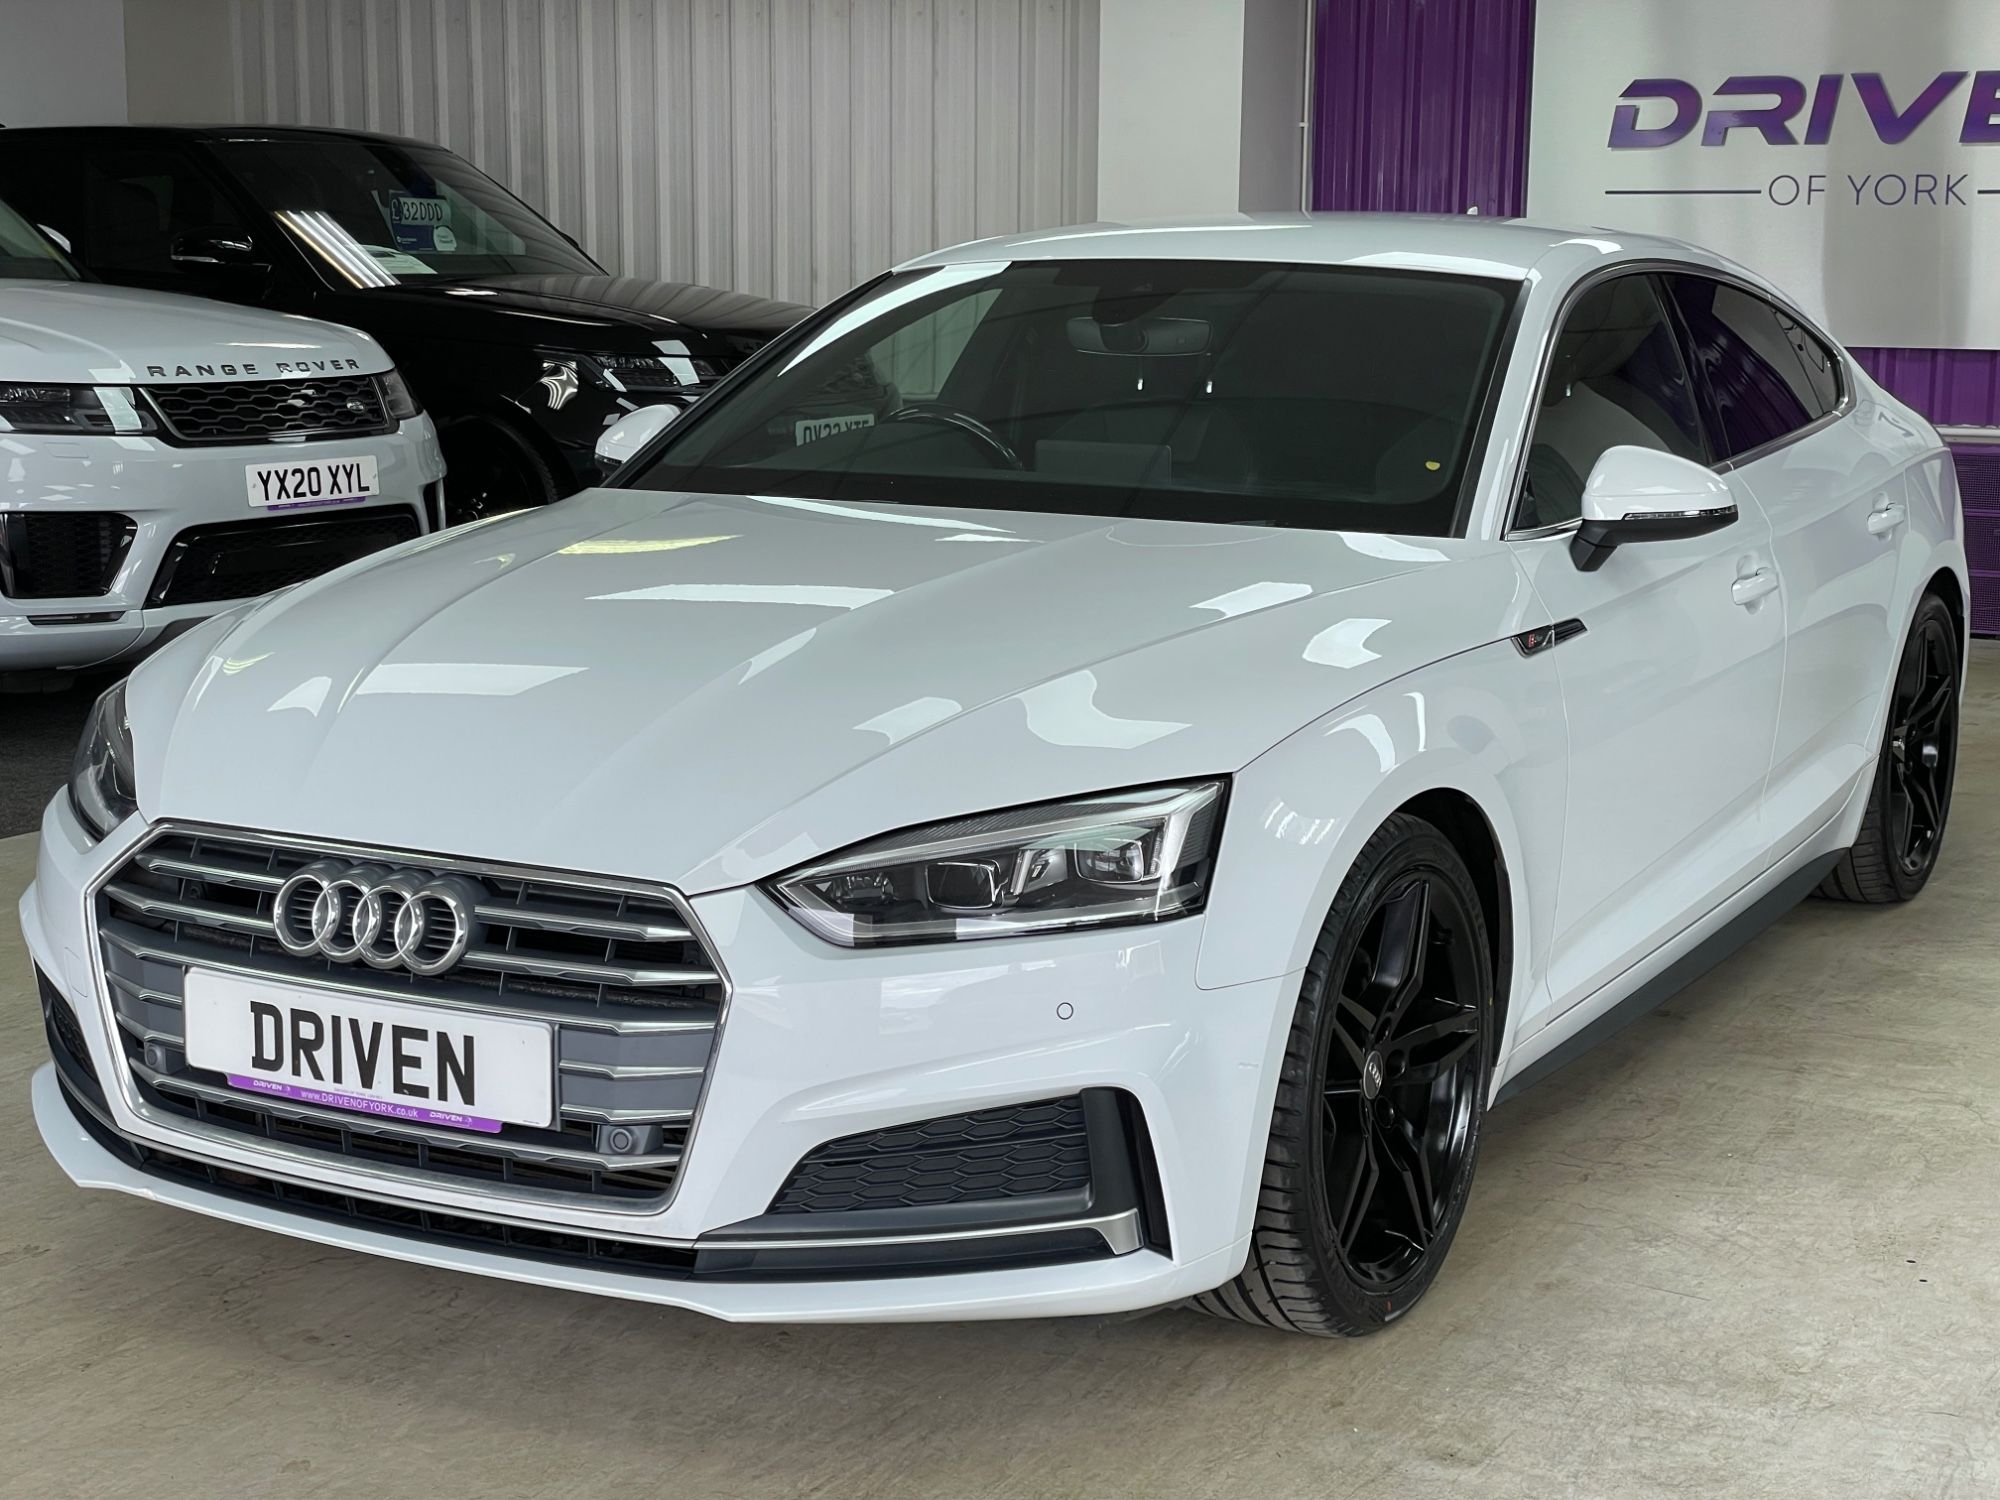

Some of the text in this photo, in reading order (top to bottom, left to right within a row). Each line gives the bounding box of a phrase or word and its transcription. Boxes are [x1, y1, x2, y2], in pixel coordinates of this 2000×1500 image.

[1769, 174, 1969, 206] OF YORK
[146, 358, 360, 377] RANGE ROVER
[257, 463, 370, 501] YX20 XYL
[250, 1001, 475, 1106] DRIVEN
[253, 1079, 283, 1091] DRIVEN
[302, 1091, 418, 1118] www.DRIVENOFYORK.co.uk
[429, 1111, 463, 1123] DRIVEN
